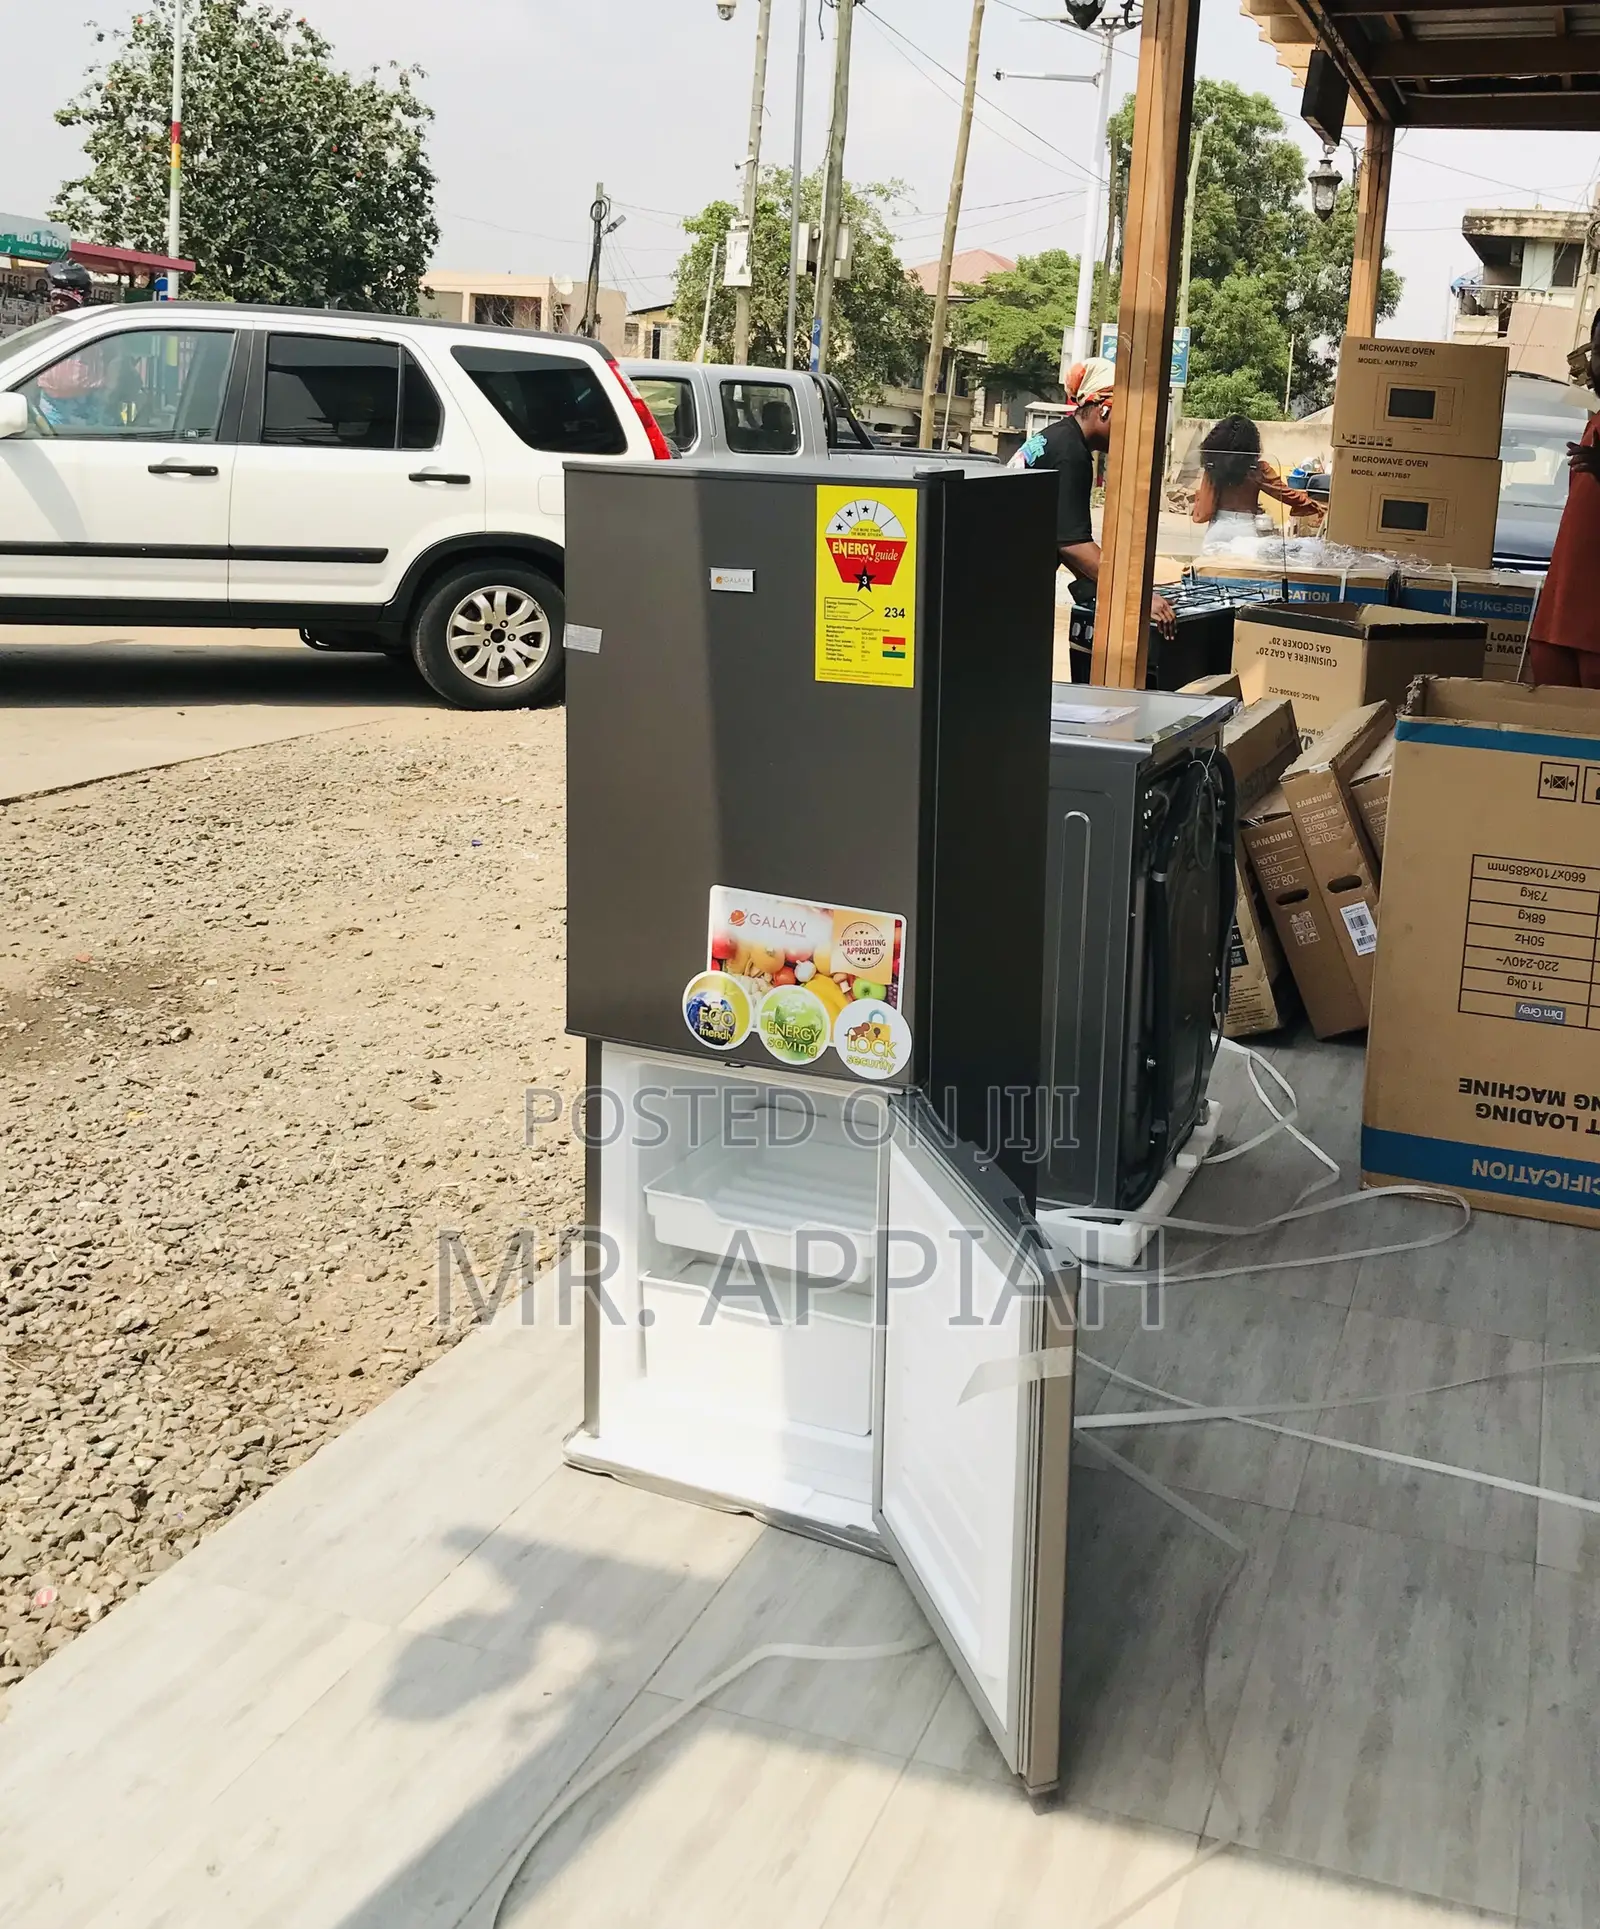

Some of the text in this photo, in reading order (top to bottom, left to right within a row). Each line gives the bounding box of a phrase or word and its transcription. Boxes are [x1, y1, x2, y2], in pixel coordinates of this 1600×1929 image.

[16, 231, 39, 245] BUS
[1358, 343, 1436, 357] MICROWAVE OVEN
[1357, 357, 1383, 367] MODEL:
[1352, 455, 1429, 468] MICROWAVE OVEN
[832, 539, 899, 564] ENERGY guide
[861, 575, 868, 586] 3
[883, 606, 906, 619] 234
[1442, 599, 1531, 615] NS-11KG-SBD
[1282, 638, 1314, 651] COOKER
[1315, 644, 1332, 654] GAS
[1270, 648, 1286, 659] GAZ
[1286, 652, 1295, 662] À
[1294, 652, 1338, 668] CUISINIÈRE
[1295, 791, 1333, 809] SAMSUNG
[1250, 829, 1294, 849] SAMSUNG
[1487, 861, 1586, 884] 660x710x885mm
[1519, 886, 1549, 902] 73kg
[749, 912, 807, 934] GALAXY
[1517, 909, 1547, 925] 68kg
[862, 937, 887, 948] RATING
[1514, 933, 1545, 947] 50Hz
[846, 946, 881, 956] APPROVED
[1506, 975, 1544, 992] 11.0kg
[699, 1007, 737, 1028] ECO
[1518, 1004, 1564, 1021] Dim Grey
[766, 1020, 823, 1043] ENERGY
[767, 1036, 818, 1058] saving
[846, 1034, 897, 1060] LOCK
[846, 1053, 896, 1074] security
[1458, 1077, 1566, 1108] MACHINE
[1475, 1102, 1579, 1132] LOADING
